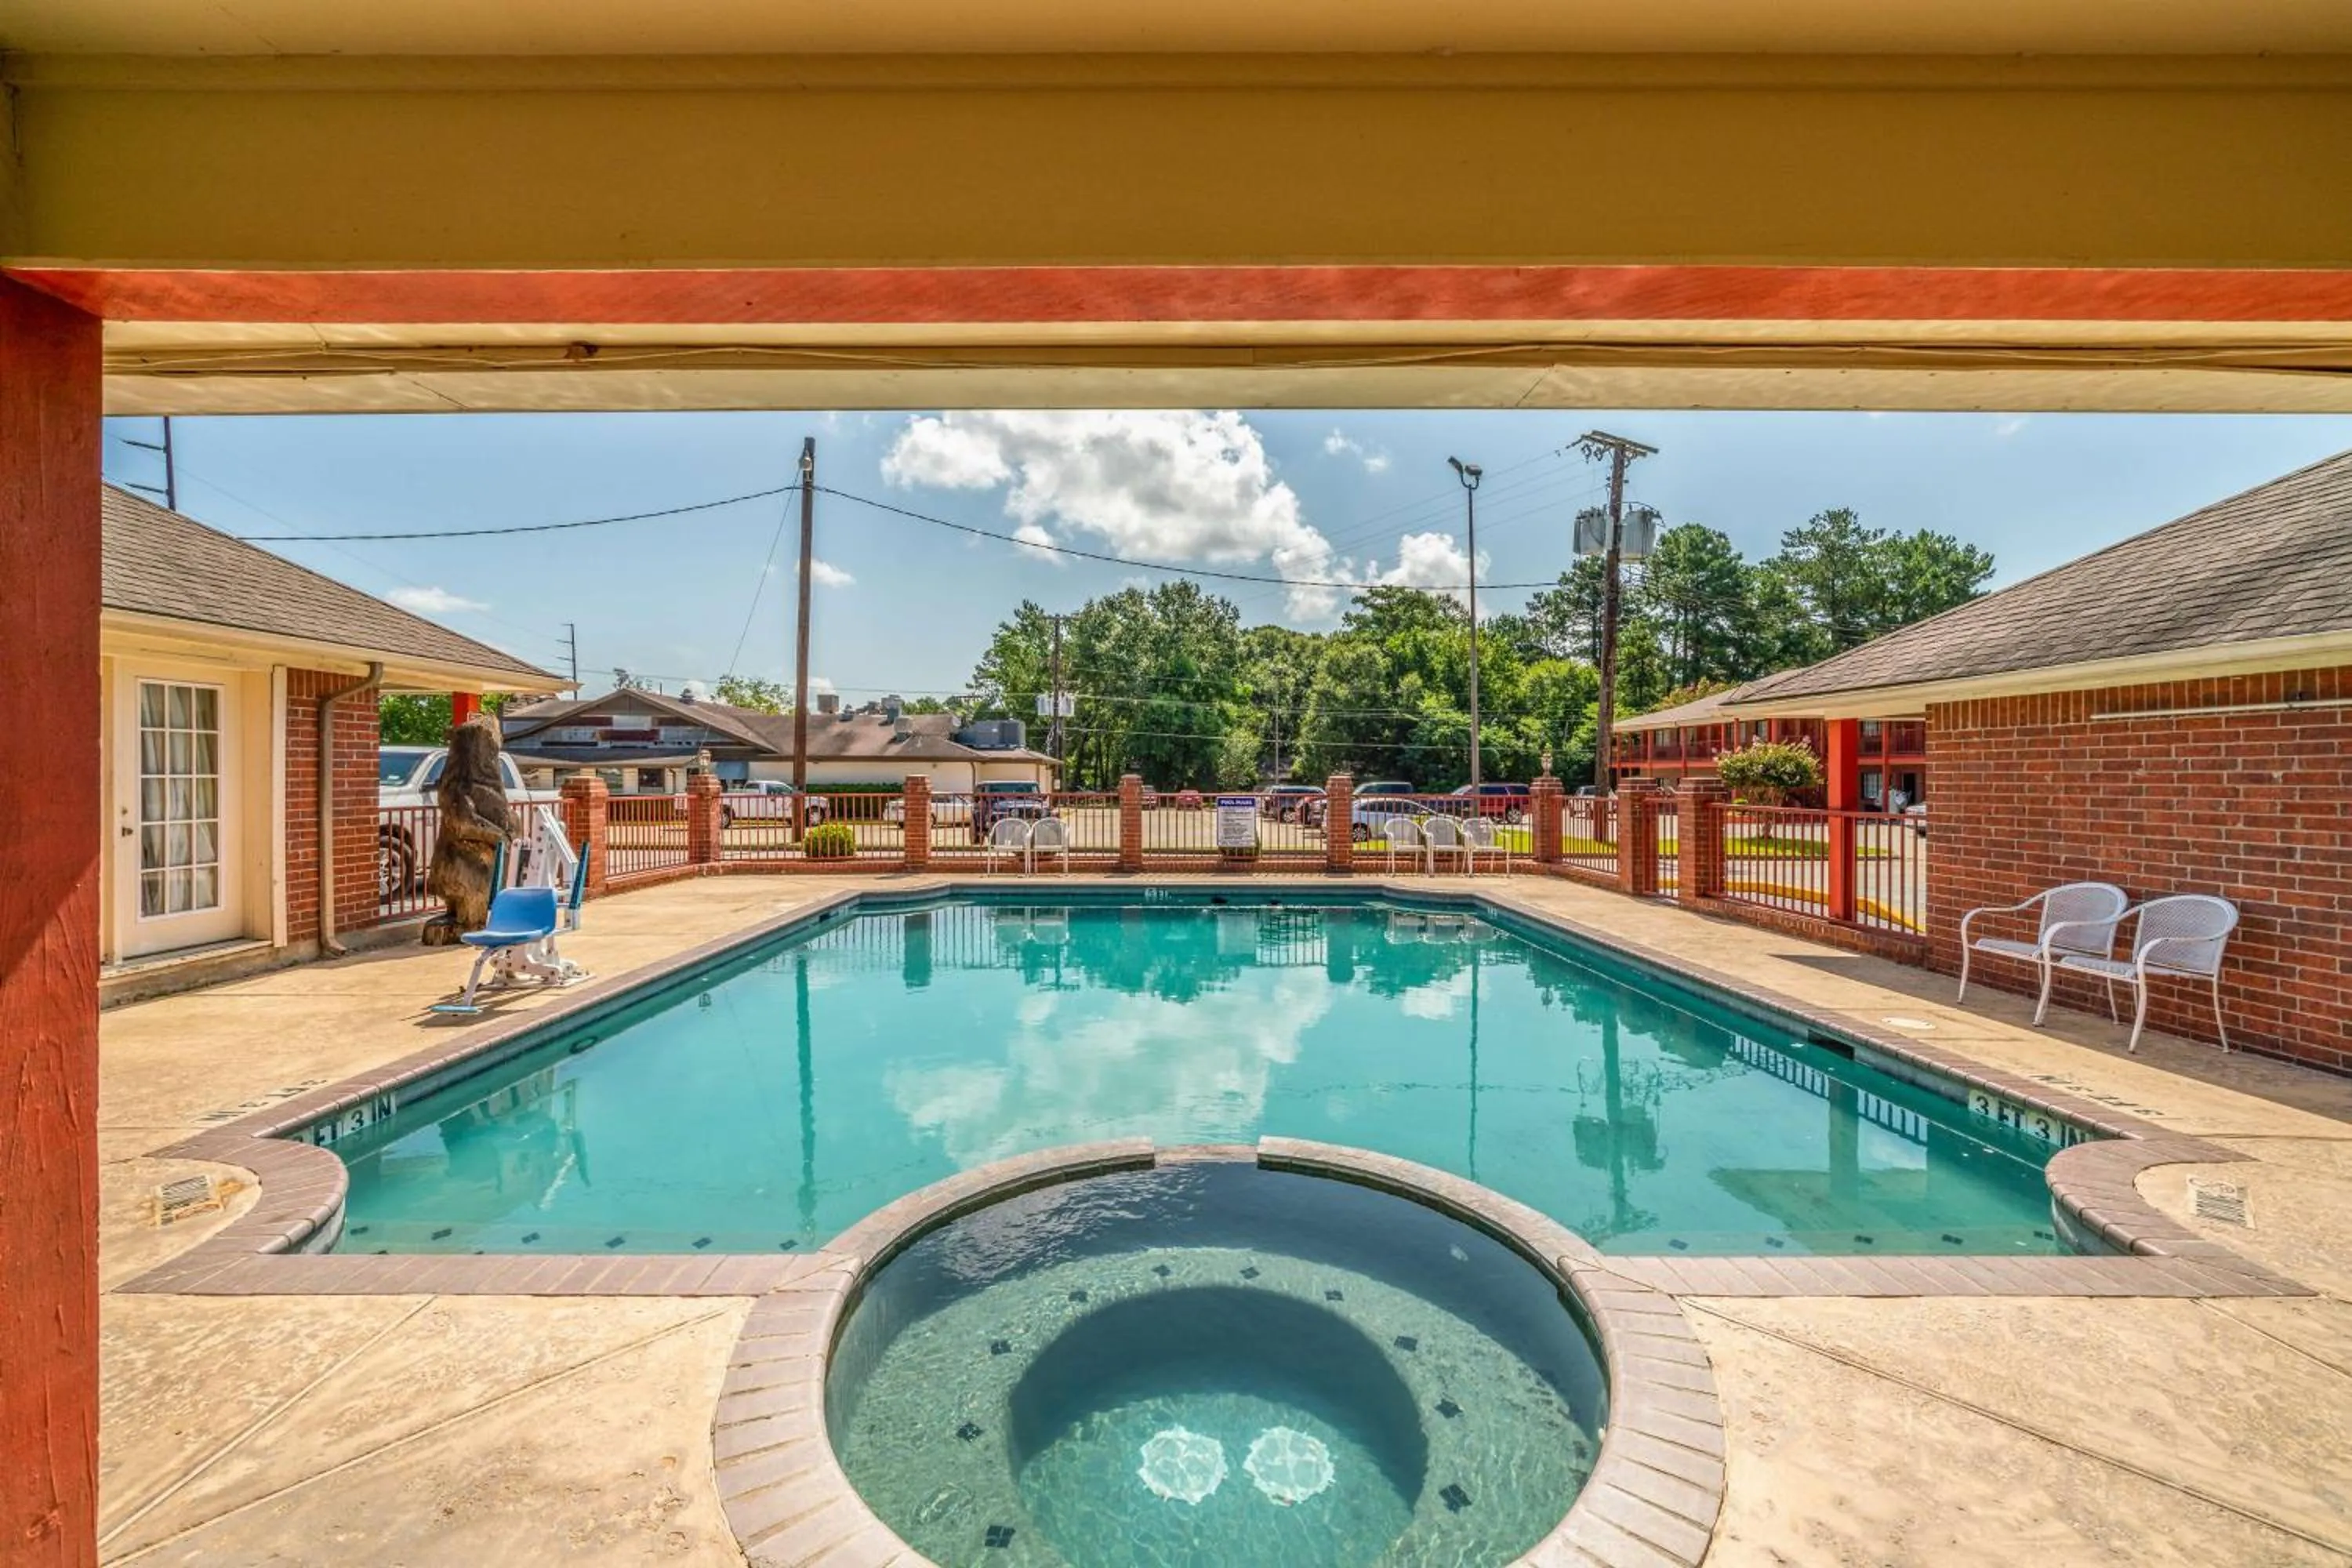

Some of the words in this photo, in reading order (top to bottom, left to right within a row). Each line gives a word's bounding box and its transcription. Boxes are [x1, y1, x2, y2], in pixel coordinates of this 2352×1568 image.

[350, 1109, 364, 1131] 3
[372, 1094, 390, 1122] IN
[1976, 1095, 1989, 1116] 3
[1998, 1100, 2025, 1129] FT
[2034, 1118, 2050, 1140] 3
[2060, 1124, 2086, 1148] IN
